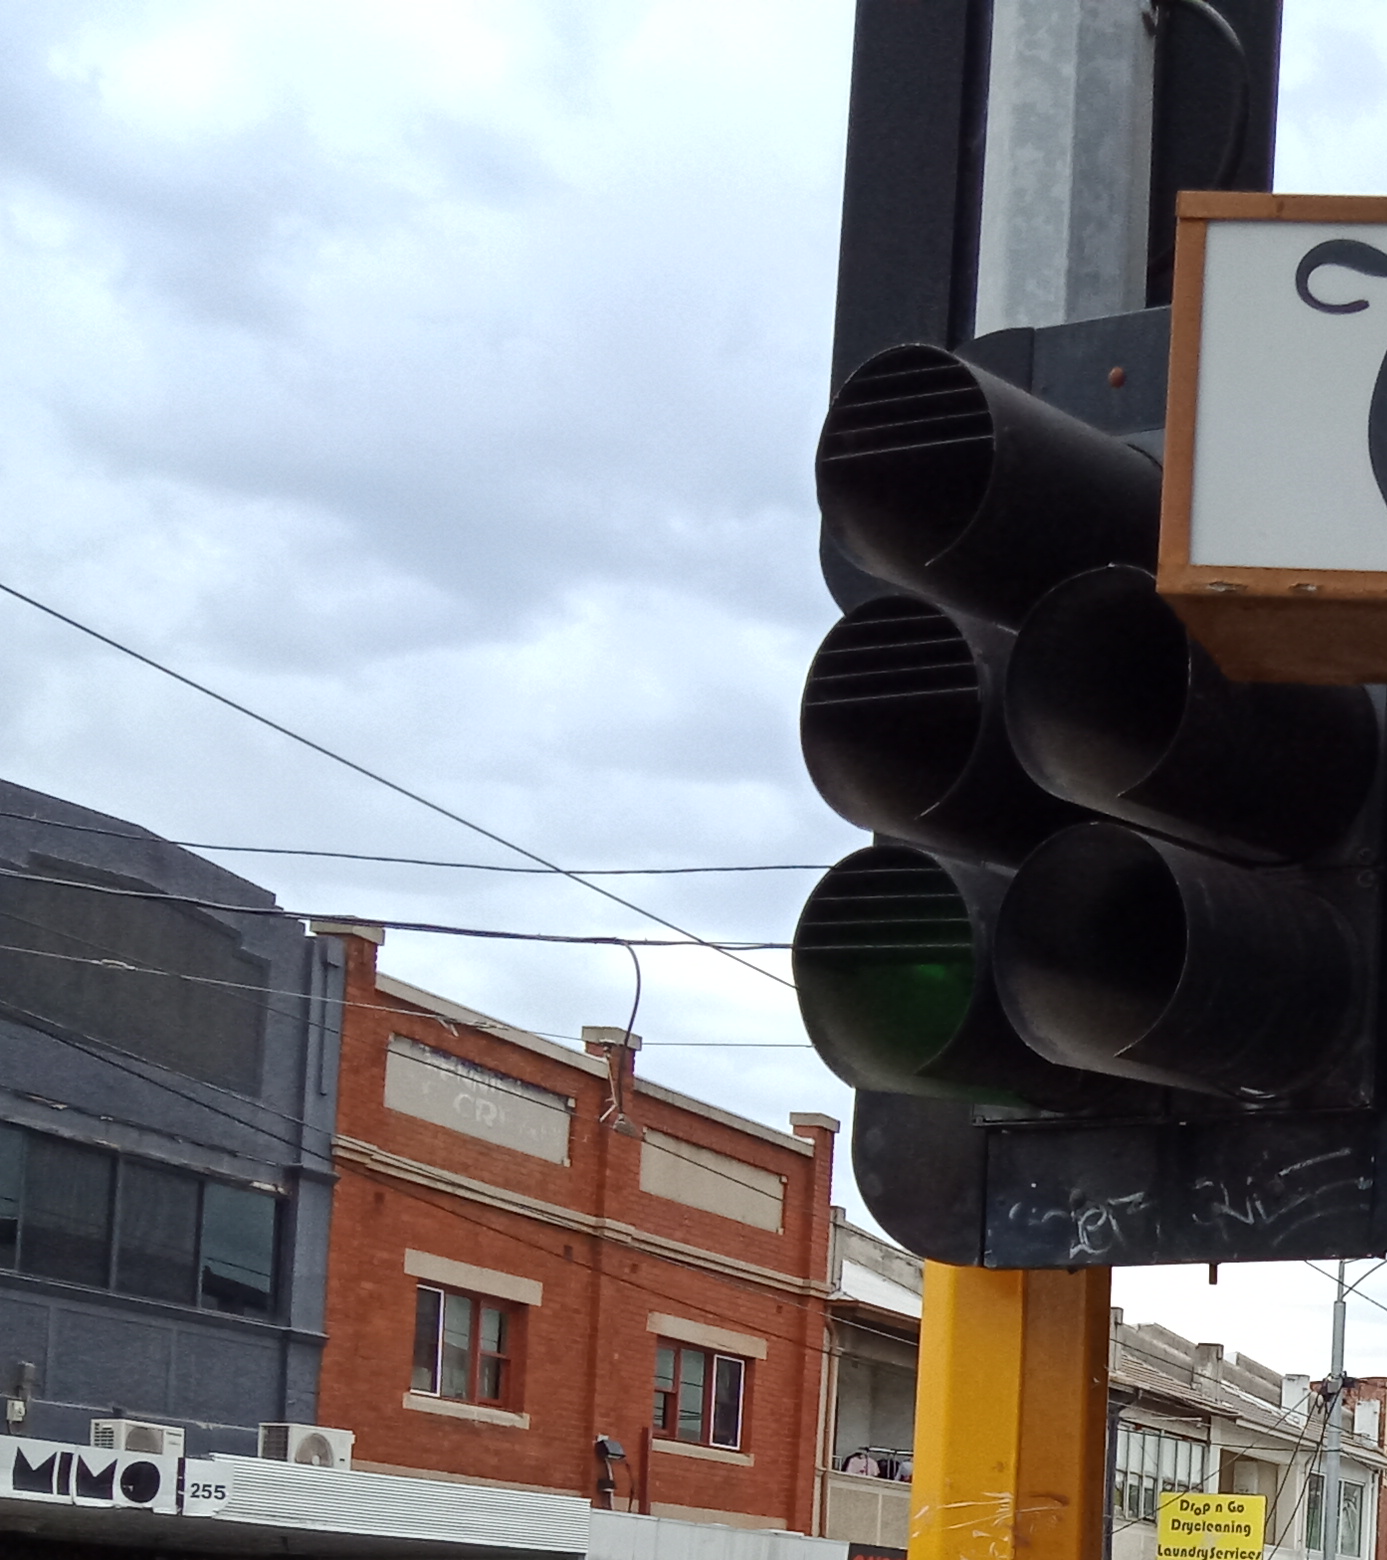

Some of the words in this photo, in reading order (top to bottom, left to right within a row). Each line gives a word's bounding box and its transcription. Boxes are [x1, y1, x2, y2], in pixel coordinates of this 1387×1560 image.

[12, 1446, 161, 1503] MIMO
[190, 1482, 227, 1501] 255
[1180, 1499, 1211, 1516] Drop
[1215, 1503, 1223, 1513] n
[1227, 1501, 1245, 1513] Go
[1171, 1518, 1251, 1538] Drycleaning
